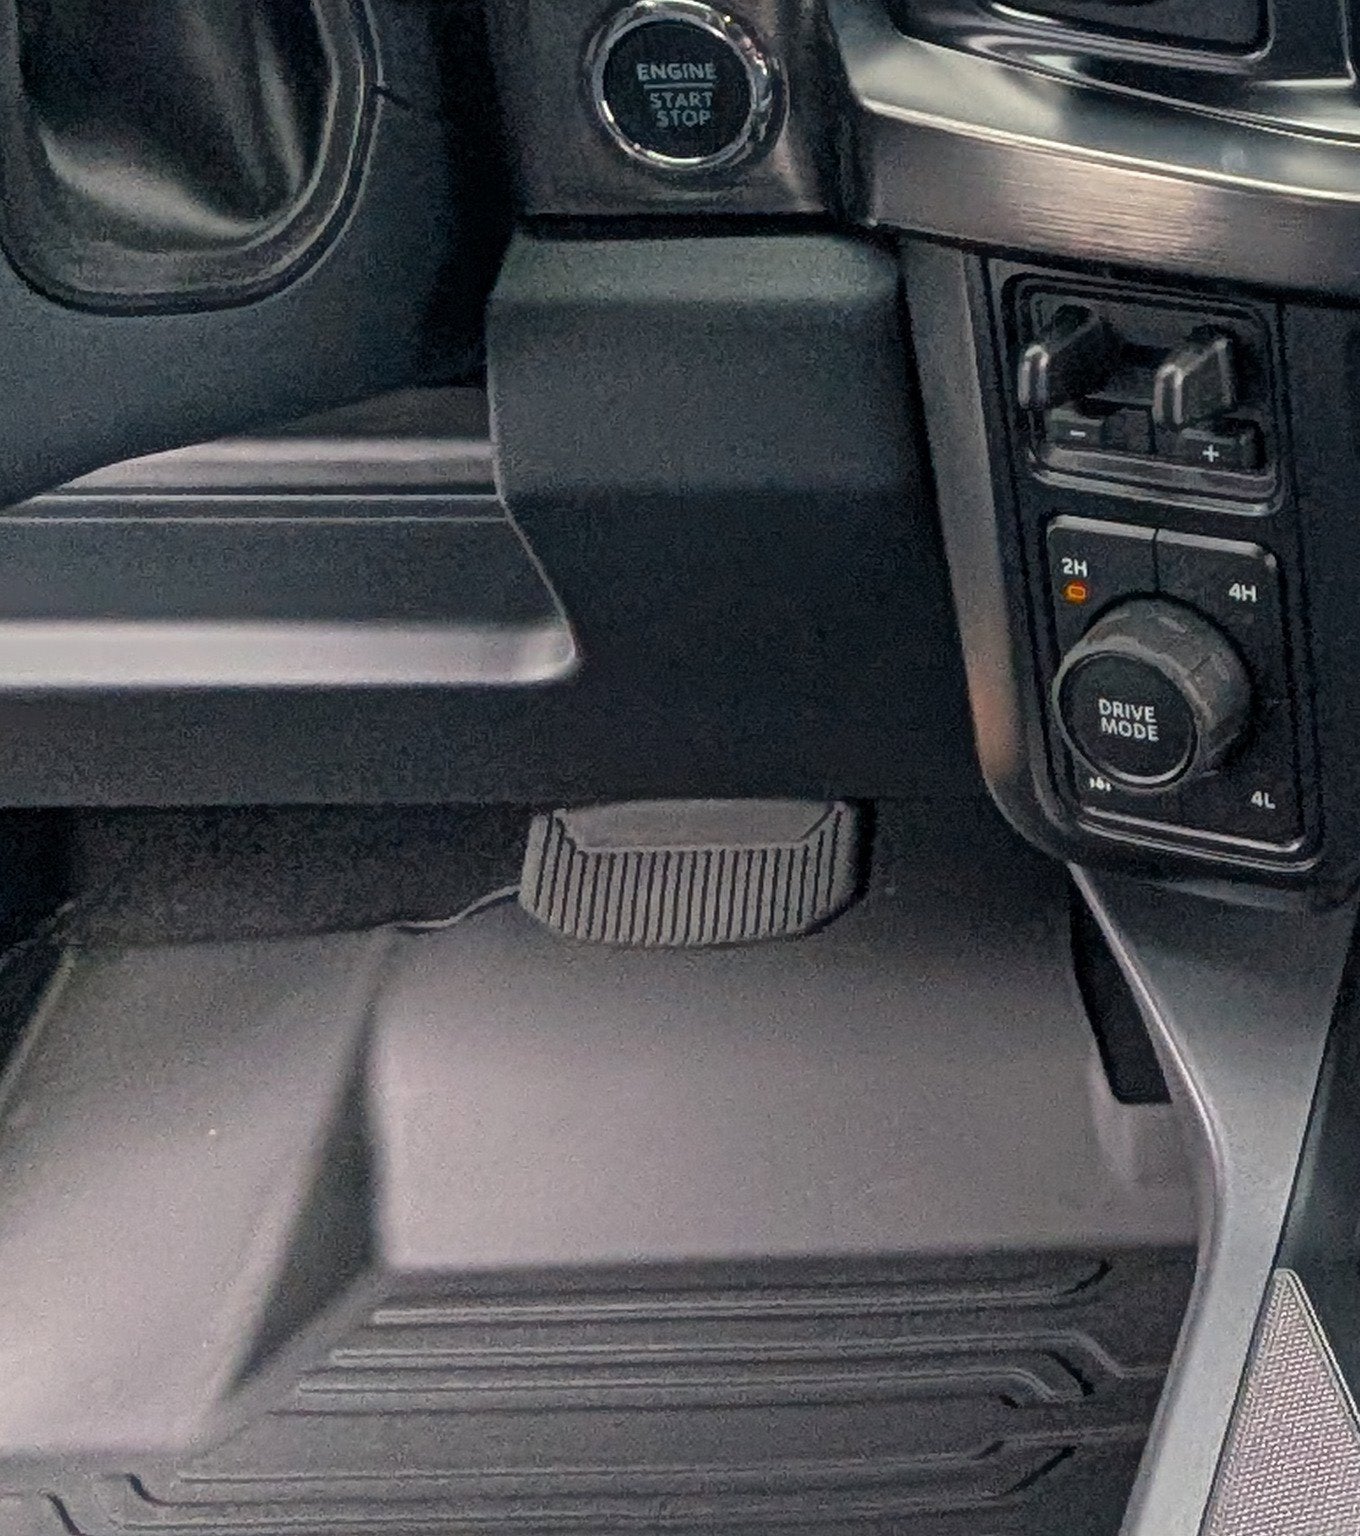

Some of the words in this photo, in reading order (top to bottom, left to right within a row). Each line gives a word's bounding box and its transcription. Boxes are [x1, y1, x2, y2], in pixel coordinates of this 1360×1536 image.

[637, 62, 717, 81] ENGINE
[650, 91, 713, 108] START
[656, 111, 711, 128] STOP
[1061, 558, 1088, 577] 2H
[1228, 584, 1257, 603] 4H
[1098, 699, 1156, 723] DRIVE
[1101, 719, 1159, 742] MODE
[1251, 790, 1275, 809] 4L
